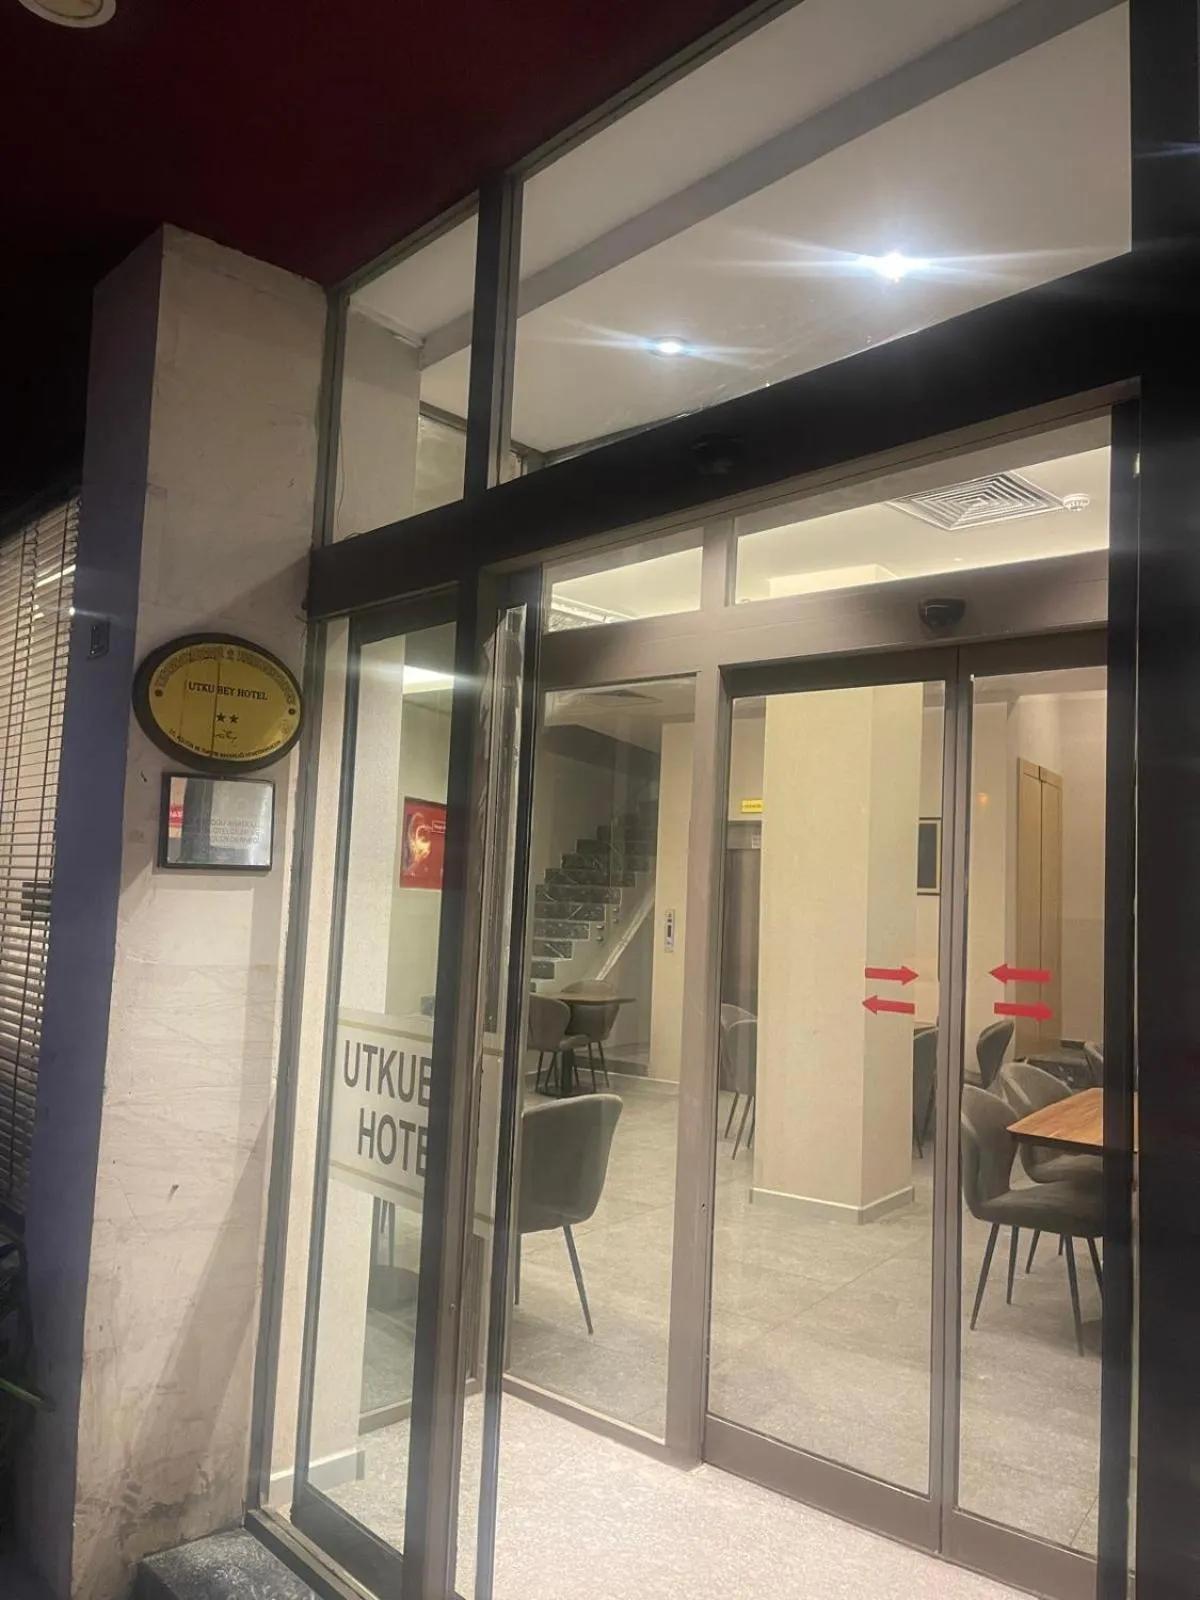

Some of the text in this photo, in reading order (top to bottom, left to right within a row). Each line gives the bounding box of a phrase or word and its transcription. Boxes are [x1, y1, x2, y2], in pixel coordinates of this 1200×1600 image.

[188, 681, 267, 700] UTKU BEY HOTEL
